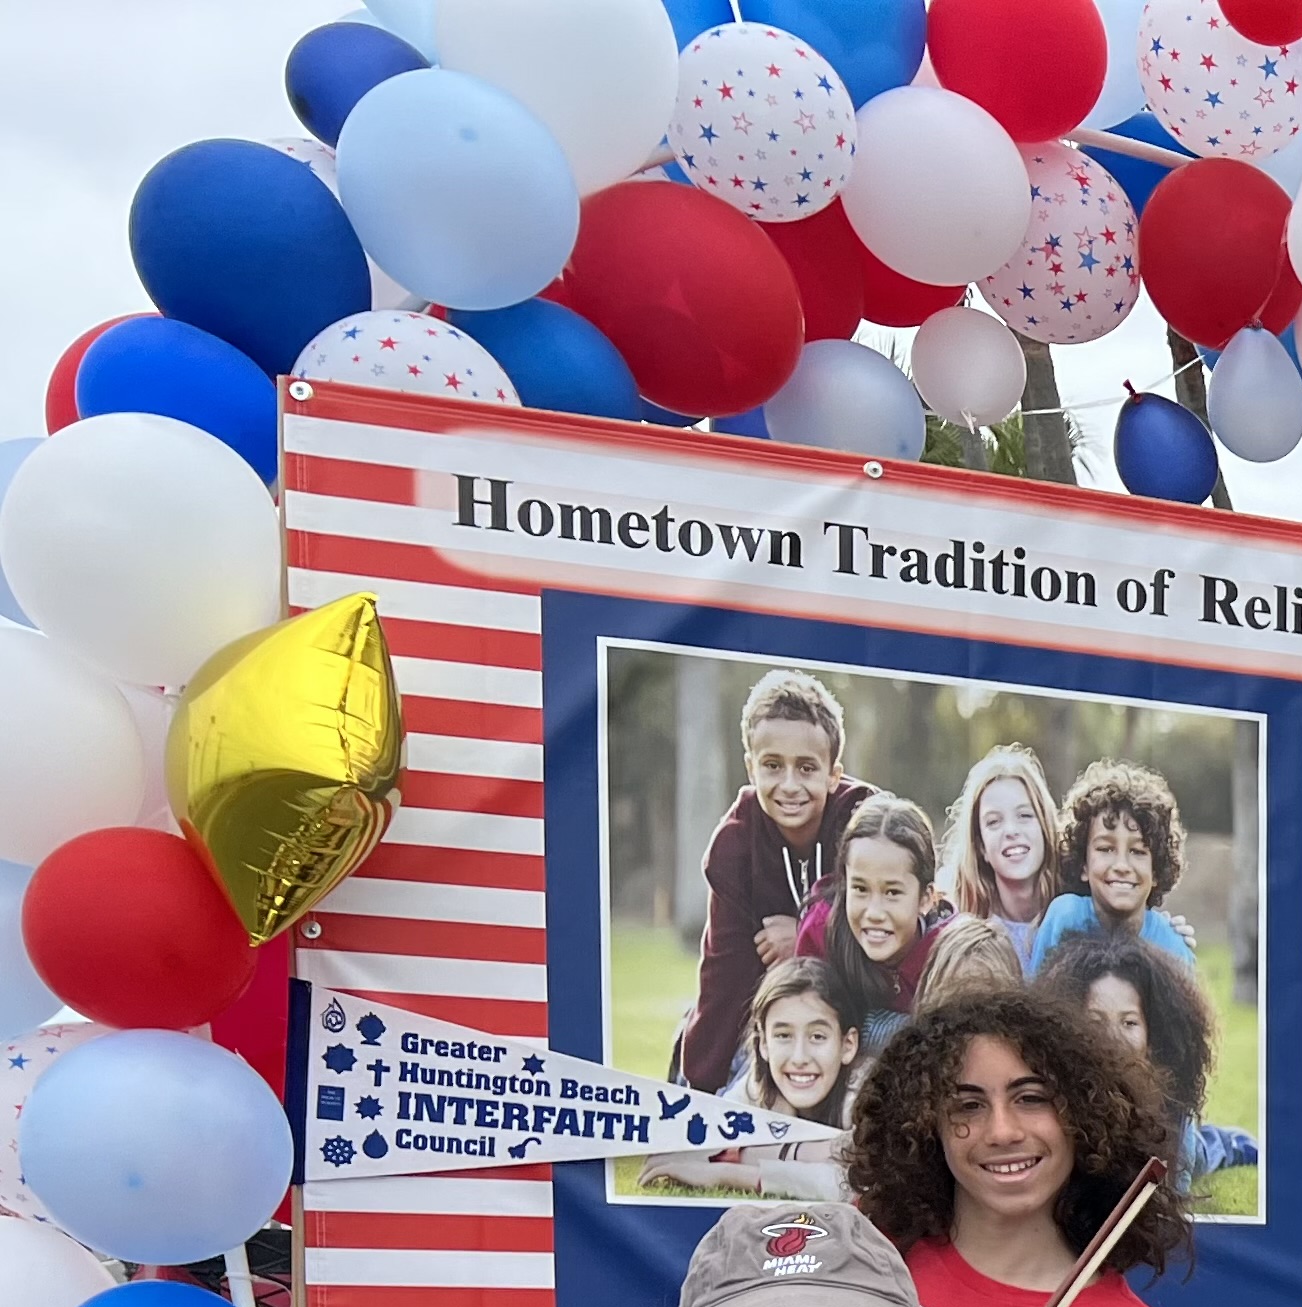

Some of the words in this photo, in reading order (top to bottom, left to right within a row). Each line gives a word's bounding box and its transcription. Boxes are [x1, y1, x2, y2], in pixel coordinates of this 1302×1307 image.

[452, 473, 803, 570] Hometown
[823, 521, 1098, 607] Tradition
[1116, 569, 1176, 617] of
[400, 1032, 507, 1062] Greater
[399, 1061, 551, 1098] Huntington
[560, 1079, 640, 1106] Beach
[397, 1092, 650, 1143] INTERFAITH
[395, 1129, 496, 1157] Council
[763, 1255, 816, 1270] MIAMI
[774, 1262, 822, 1277] HEAT
